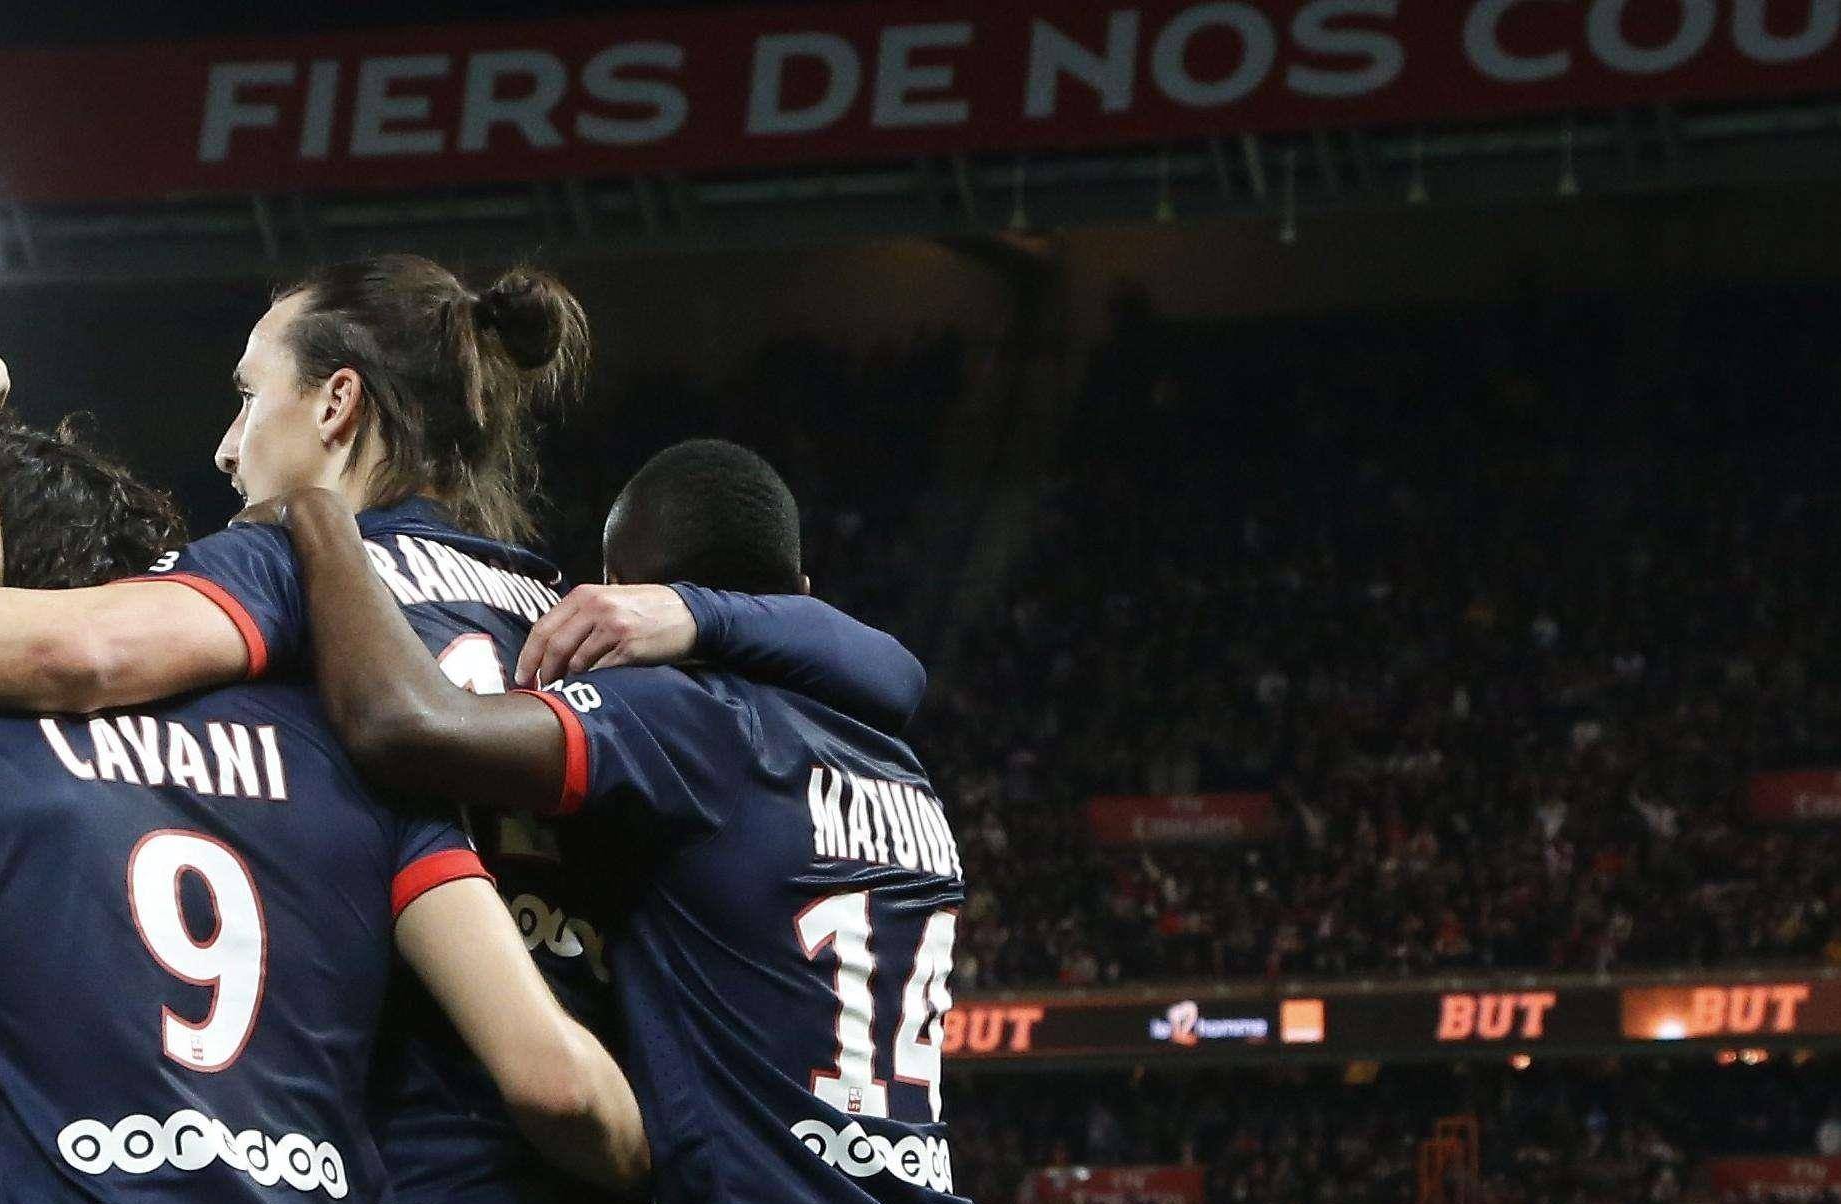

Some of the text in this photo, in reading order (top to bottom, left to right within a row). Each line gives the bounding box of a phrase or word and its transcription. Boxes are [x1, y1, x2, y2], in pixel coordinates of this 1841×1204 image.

[197, 41, 689, 163] FIERS
[745, 24, 973, 136] DE
[1023, 0, 1405, 120] NOS
[127, 828, 268, 1073] 9
[793, 890, 959, 1123] 14
[1436, 993, 1556, 1042] BUT
[1689, 983, 1812, 1035] BUT
